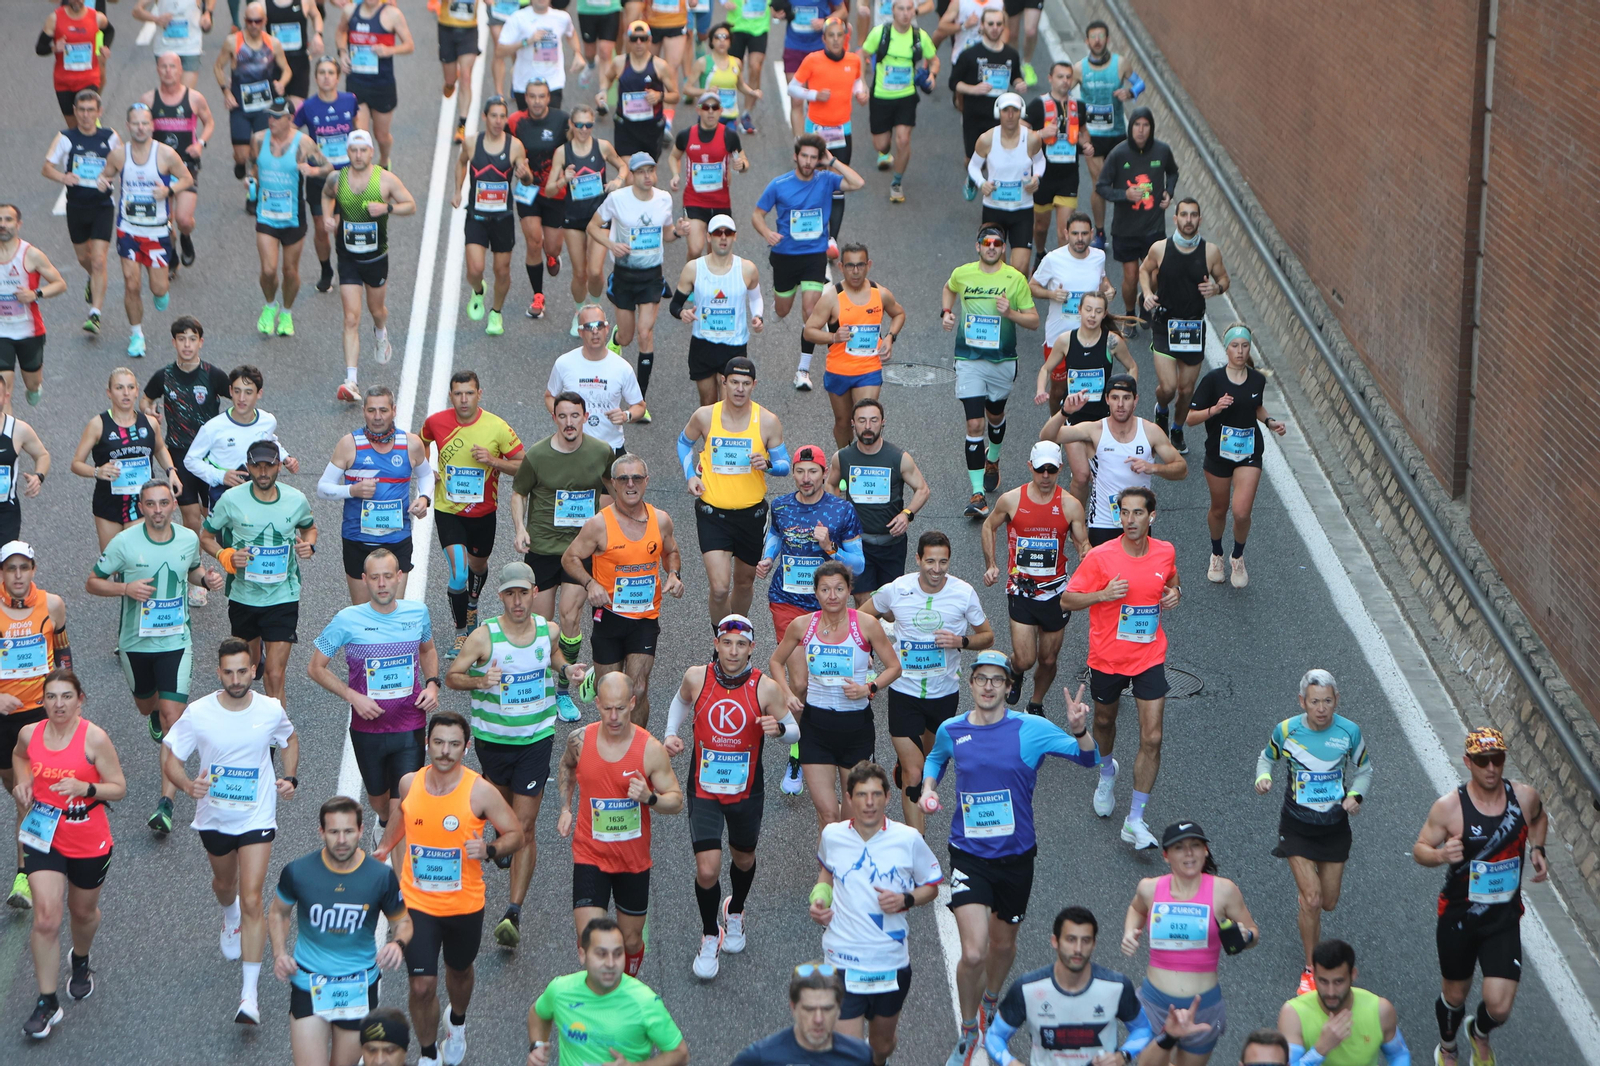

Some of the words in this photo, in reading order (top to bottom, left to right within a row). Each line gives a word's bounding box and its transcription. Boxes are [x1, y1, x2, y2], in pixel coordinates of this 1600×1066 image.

[579, 376, 608, 384] IRONMAN
[724, 439, 747, 447] ZURICH
[125, 459, 146, 467] ZURICH
[377, 502, 398, 510] ZURICH
[1031, 540, 1053, 548] ZURICH
[262, 547, 285, 555] ZURICH
[797, 558, 821, 566] ZURICH
[158, 600, 180, 608] ZURICH
[1136, 607, 1158, 615] ZURICH
[156, 613, 171, 621] 4245
[850, 621, 863, 647] SPORT
[823, 646, 848, 656] ZURICH
[382, 658, 407, 667] ZURICH
[915, 655, 930, 663] 5614
[383, 673, 398, 681] 5673
[517, 673, 540, 682] ZURICH
[380, 682, 402, 690] ANTOINE
[517, 687, 532, 696] 5188
[719, 705, 738, 730] K
[711, 735, 742, 745] Kalamos
[717, 754, 743, 762] ZURICH
[42, 767, 76, 780] asics
[227, 769, 254, 777] ZURICH
[716, 768, 732, 776] 4987
[1312, 772, 1339, 781] ZURICH
[229, 793, 254, 802] MARTINS
[976, 795, 1004, 804] ZURICH
[608, 799, 634, 808] ZURICH
[978, 809, 995, 818] 5260
[414, 818, 424, 826] JR
[608, 815, 625, 823] 1635
[975, 819, 1001, 828] MARTINS
[606, 824, 628, 832] CARLOS
[426, 864, 443, 872] 3589
[1489, 863, 1516, 873] ZURICH
[1172, 906, 1202, 916] ZURICH
[837, 953, 860, 963] TIBA
